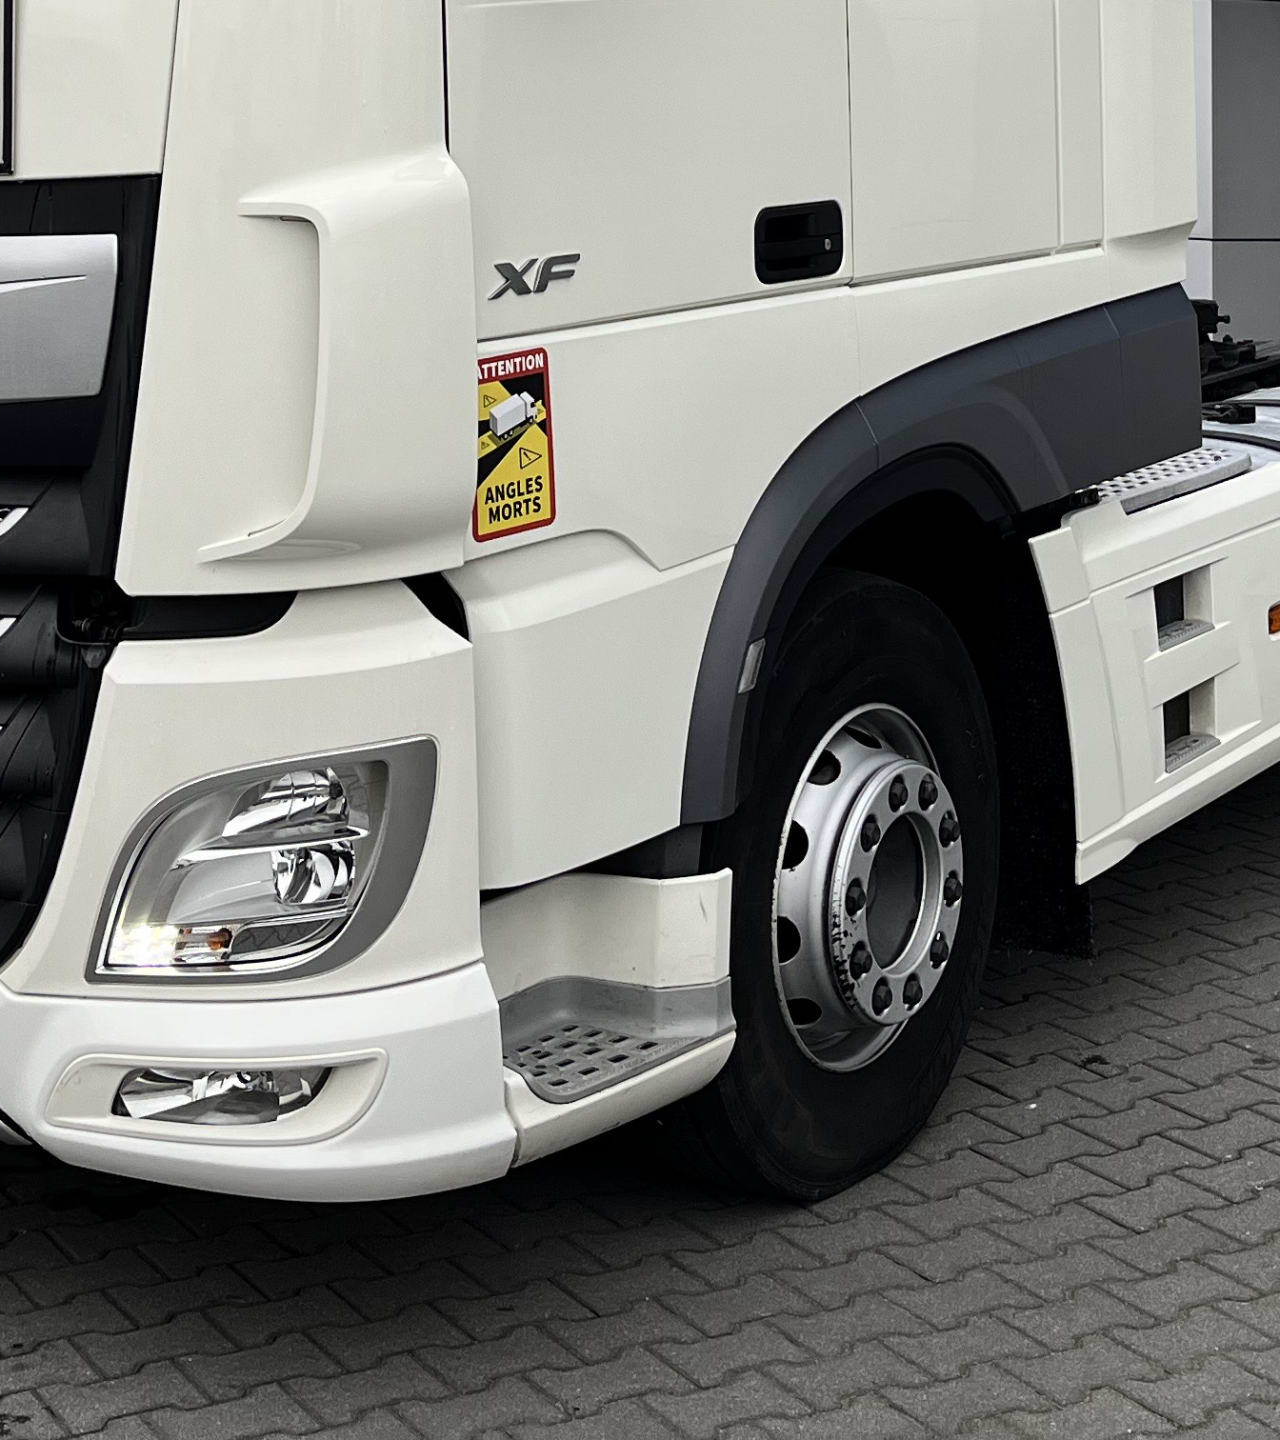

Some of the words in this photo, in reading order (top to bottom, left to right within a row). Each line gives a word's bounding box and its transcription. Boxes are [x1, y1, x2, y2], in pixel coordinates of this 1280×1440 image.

[487, 253, 581, 301] XF
[484, 475, 544, 505] ANGLES
[488, 496, 542, 525] MORTS
